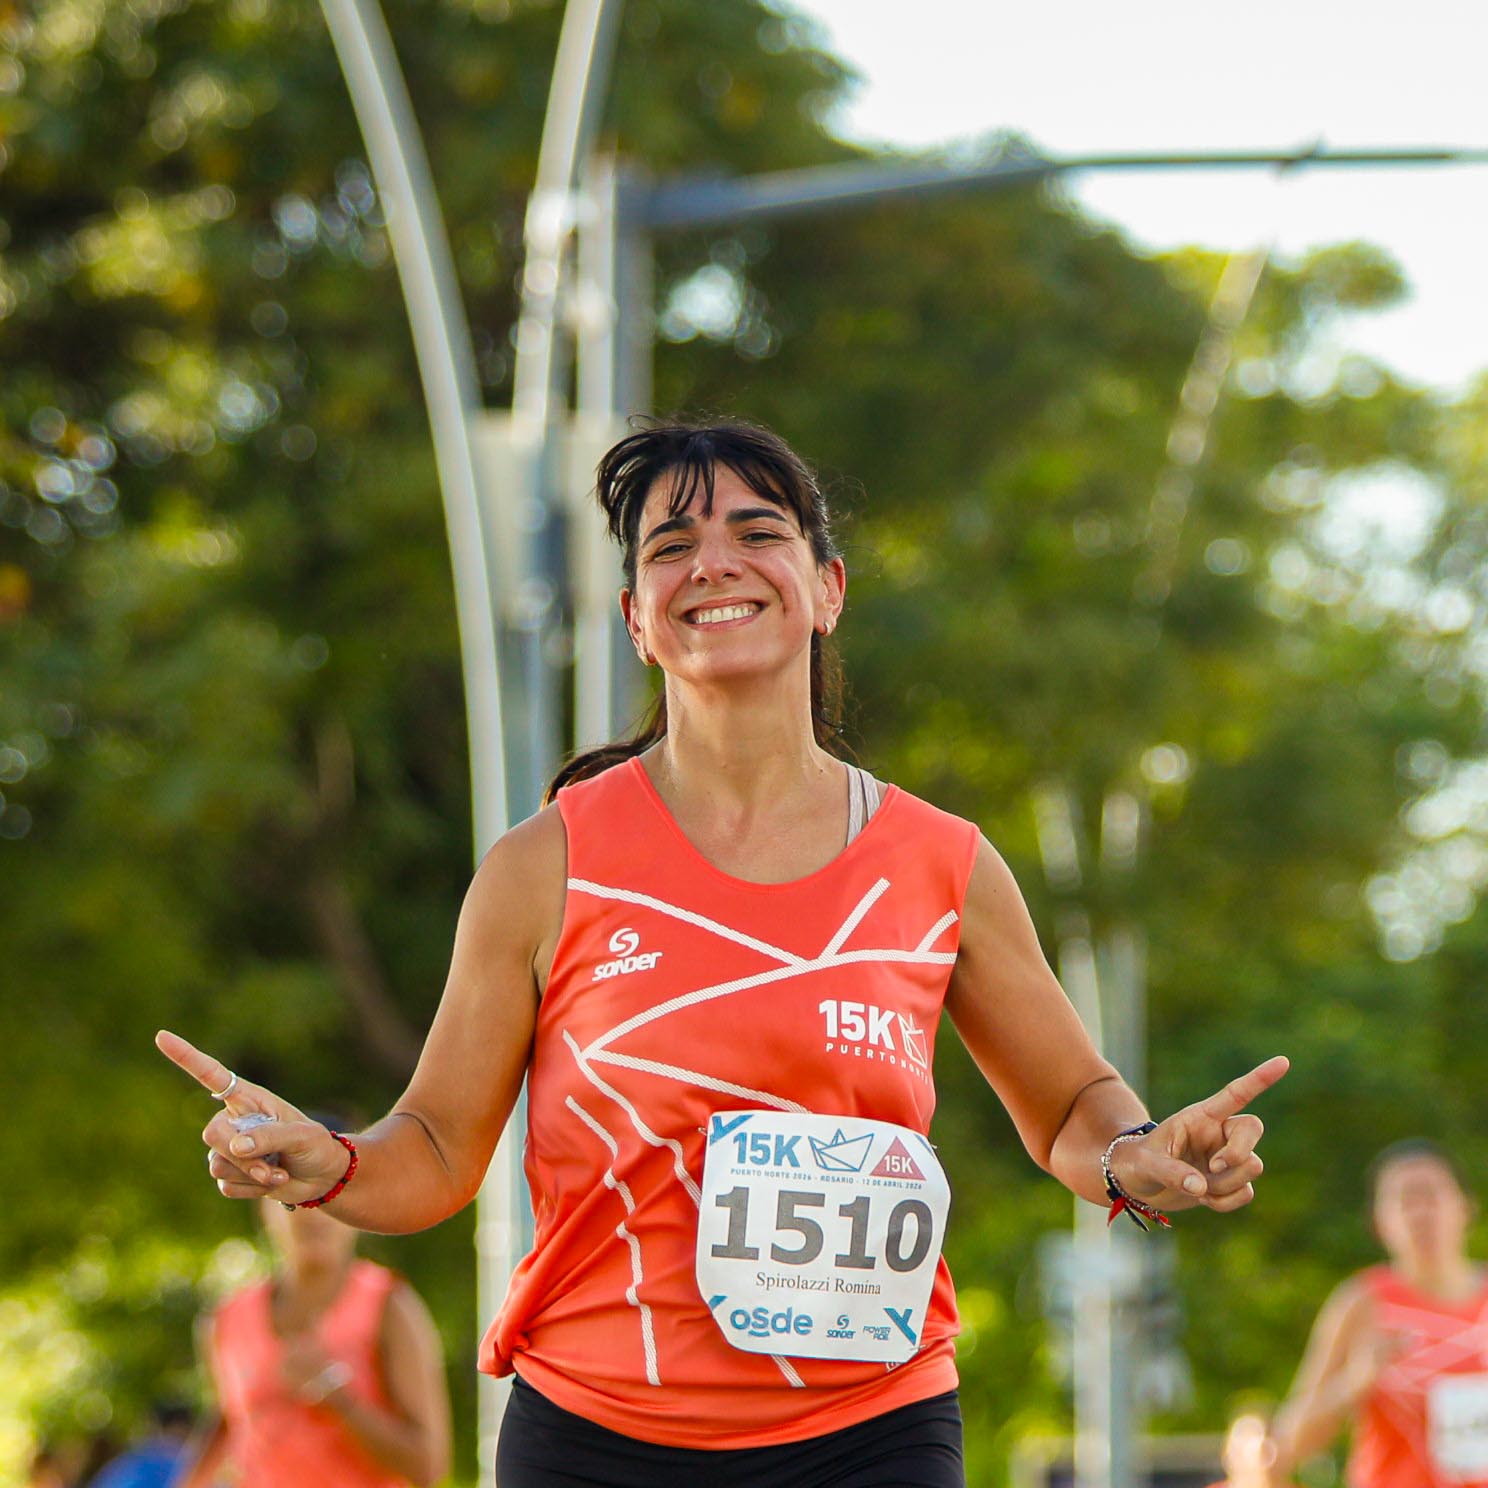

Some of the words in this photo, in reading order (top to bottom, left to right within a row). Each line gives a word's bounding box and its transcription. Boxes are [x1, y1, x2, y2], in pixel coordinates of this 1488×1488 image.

[818, 999, 896, 1051] 15K
[825, 1042, 896, 1065] PUERTO
[732, 1131, 803, 1168] 15K
[883, 1154, 914, 1175] 15K
[730, 1167, 762, 1177] PUERTO
[764, 1169, 790, 1179] NORTE
[793, 1172, 812, 1181] 2026
[820, 1175, 854, 1184] ROSARIO
[862, 1178, 870, 1186] 12
[872, 1179, 881, 1187] DE
[883, 1180, 903, 1189] ABRIL
[711, 1185, 933, 1273] 1510
[755, 1271, 830, 1291] Spirolazzi
[834, 1277, 881, 1295] Romina
